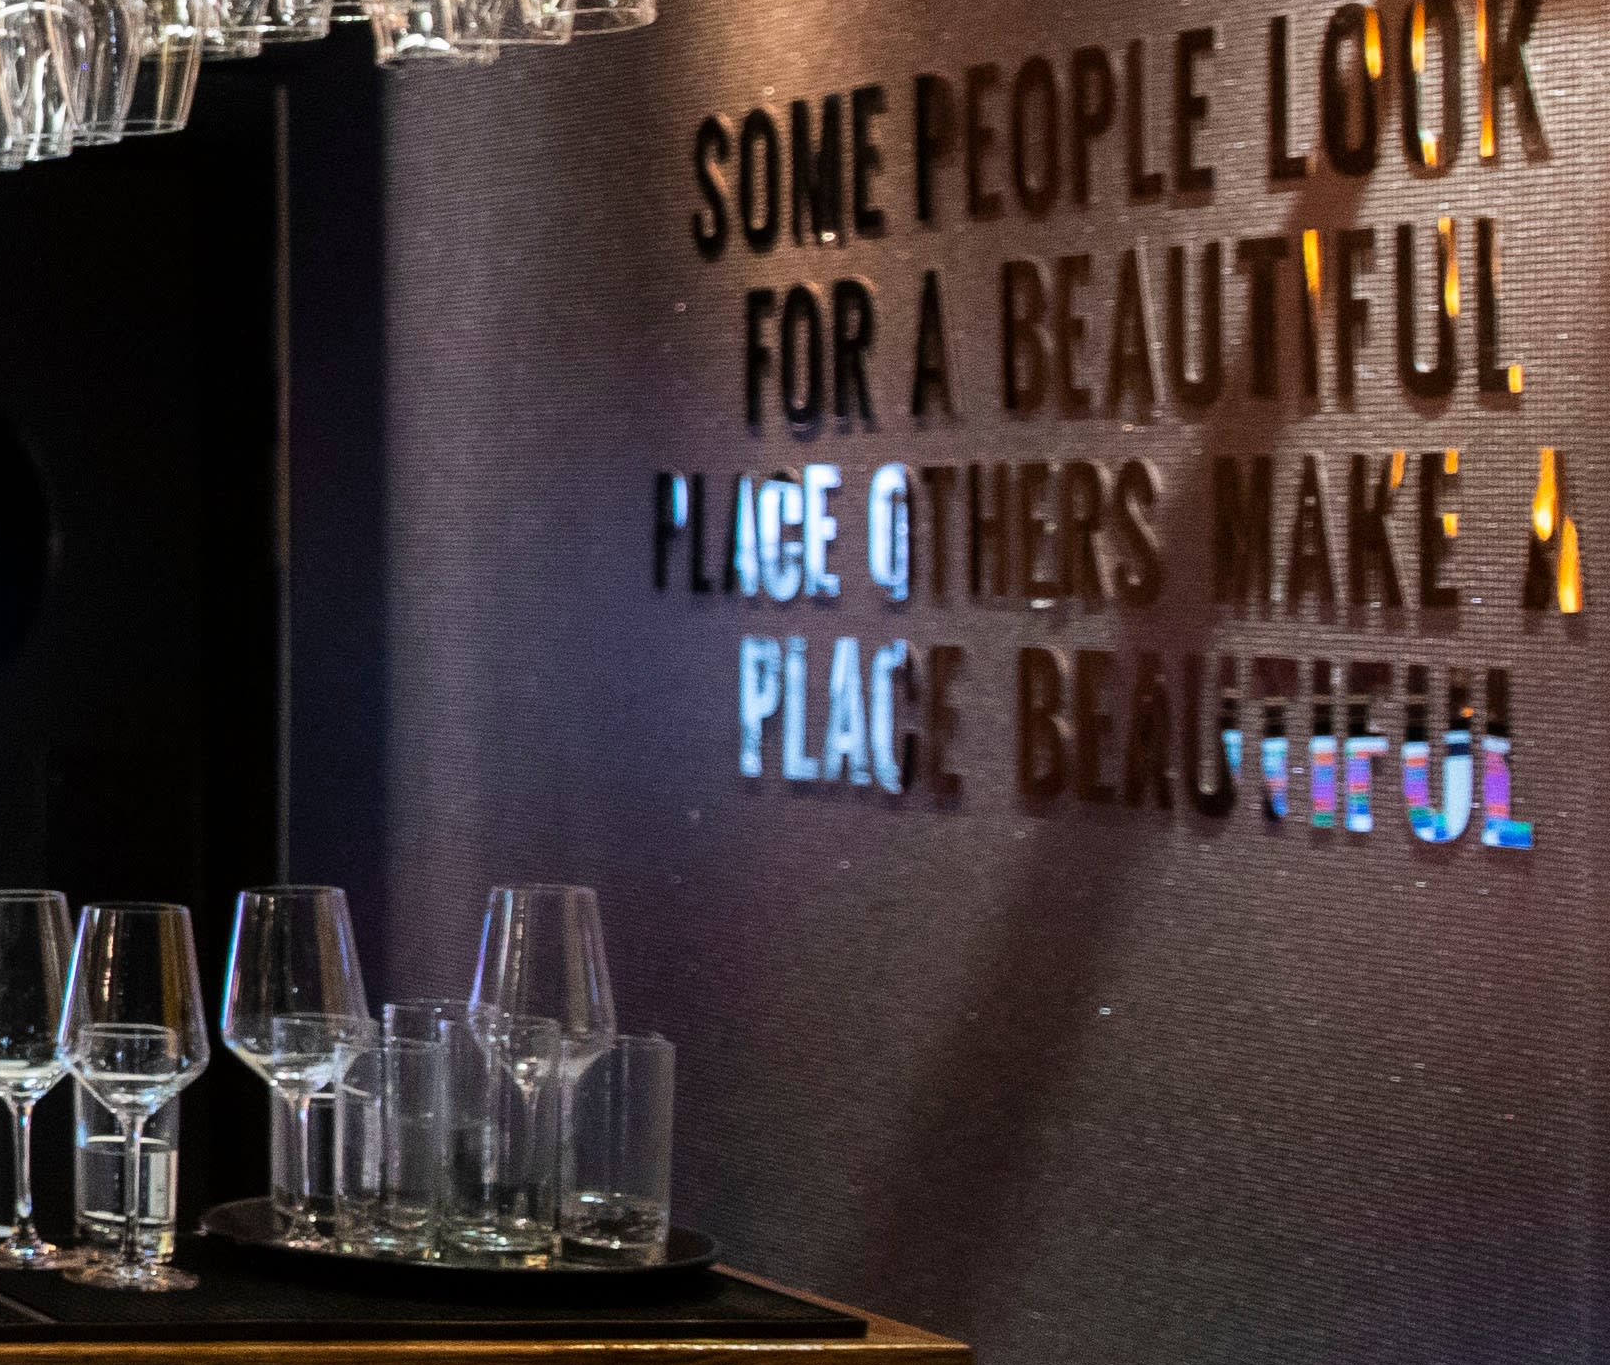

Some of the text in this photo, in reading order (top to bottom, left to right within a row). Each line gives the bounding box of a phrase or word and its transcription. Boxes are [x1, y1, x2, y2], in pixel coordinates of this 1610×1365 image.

[691, 82, 888, 260] SOME
[914, 26, 1216, 224] PEOPLE
[744, 216, 1524, 436] FOR A BEAUTIFUL
[653, 445, 1583, 614] PLACE OTHERS MAKE A
[737, 636, 1535, 850] PLACE BEAUTIFUL
